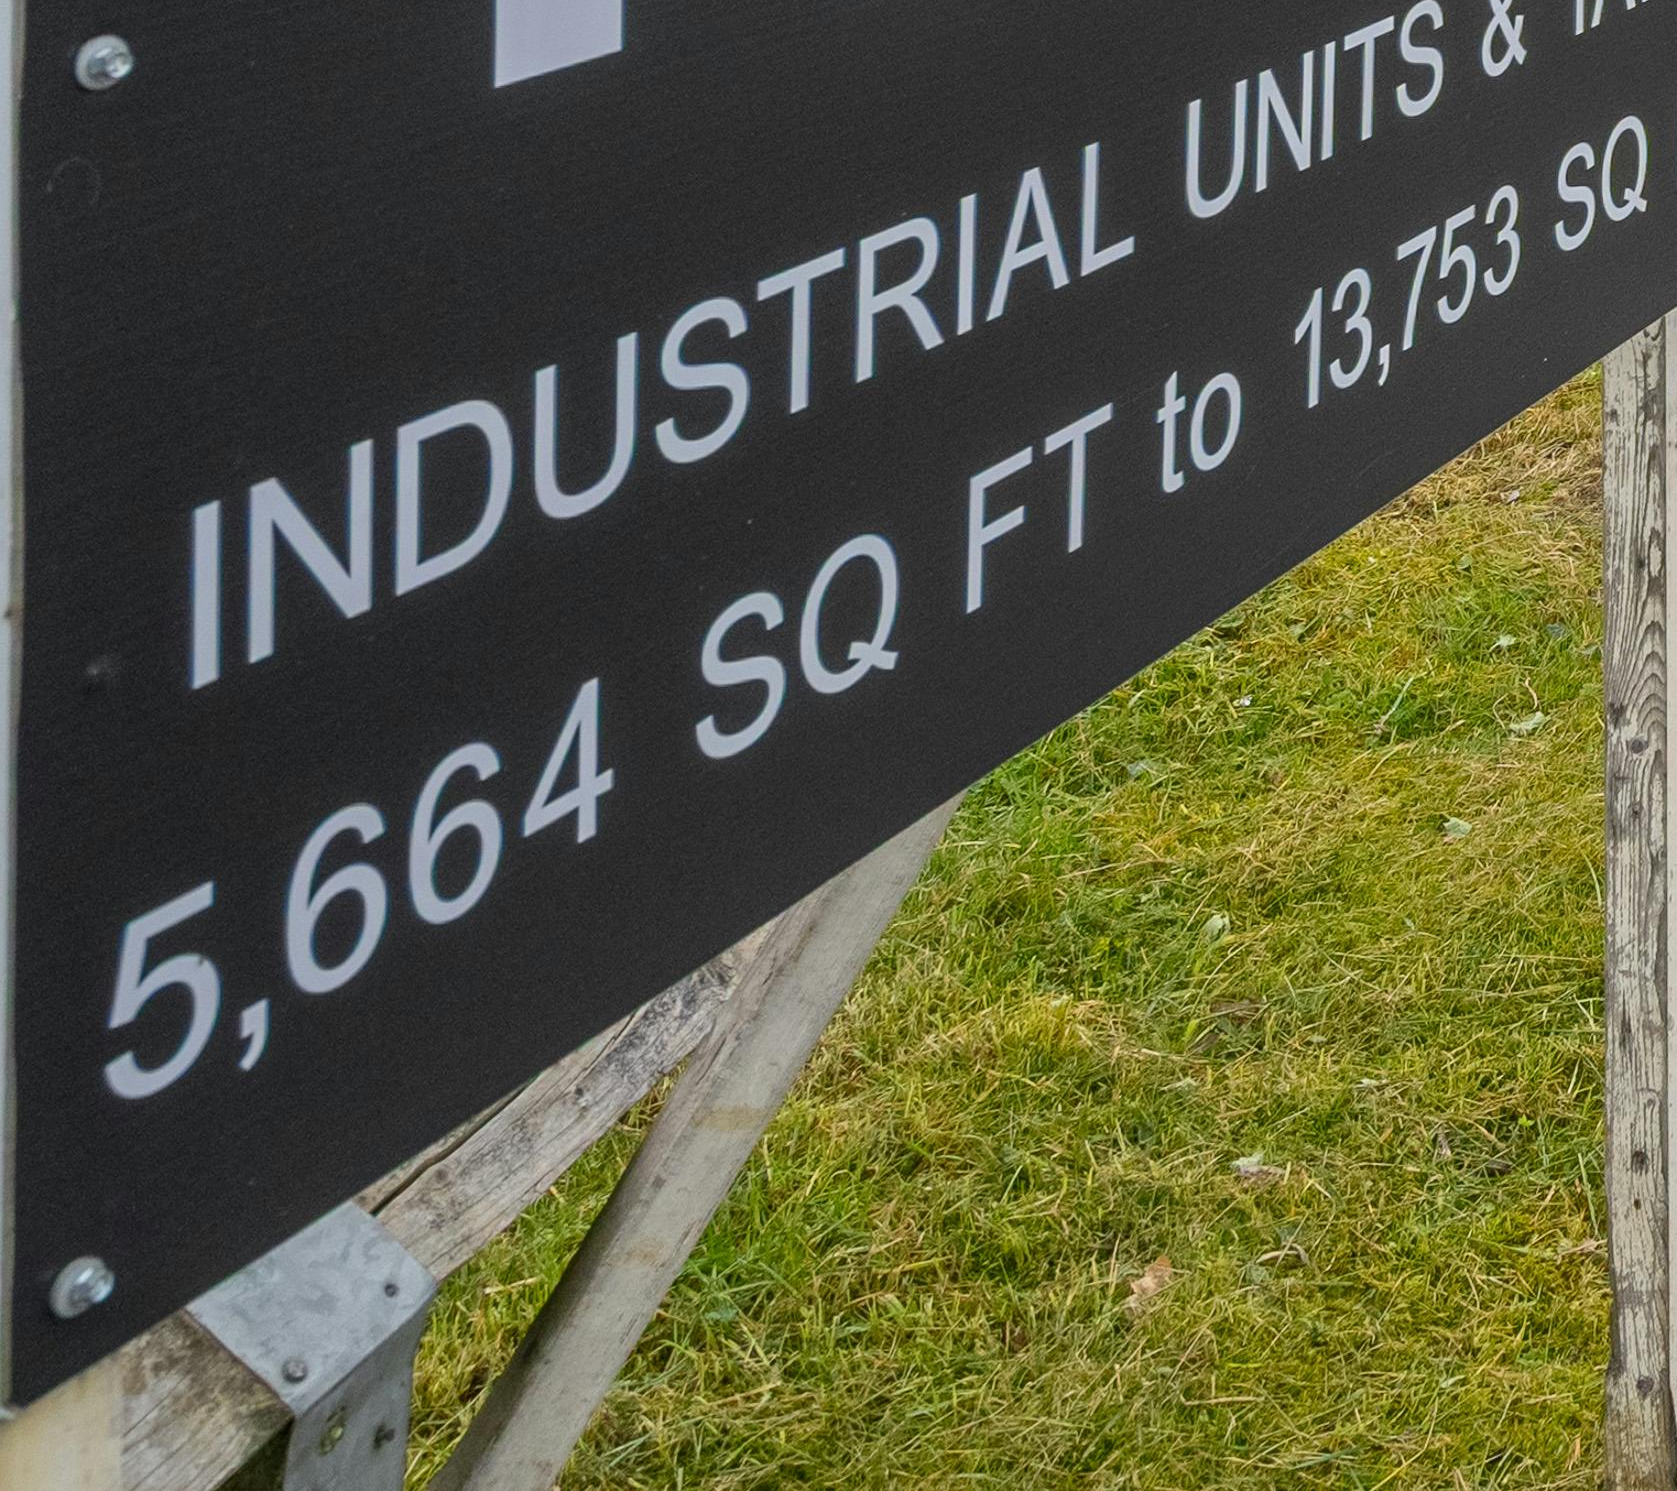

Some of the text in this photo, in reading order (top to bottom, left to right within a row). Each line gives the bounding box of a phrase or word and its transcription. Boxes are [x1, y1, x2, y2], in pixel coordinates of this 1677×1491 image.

[104, 676, 615, 1101] 5,664
[694, 533, 900, 761] SQ
[964, 403, 1114, 615] FT
[1156, 370, 1243, 494] to
[1293, 184, 1522, 409] 13,753
[1553, 115, 1649, 253] SQ
[189, 141, 1135, 690] INDUSTRIAL
[1184, 0, 1445, 219] UNITS
